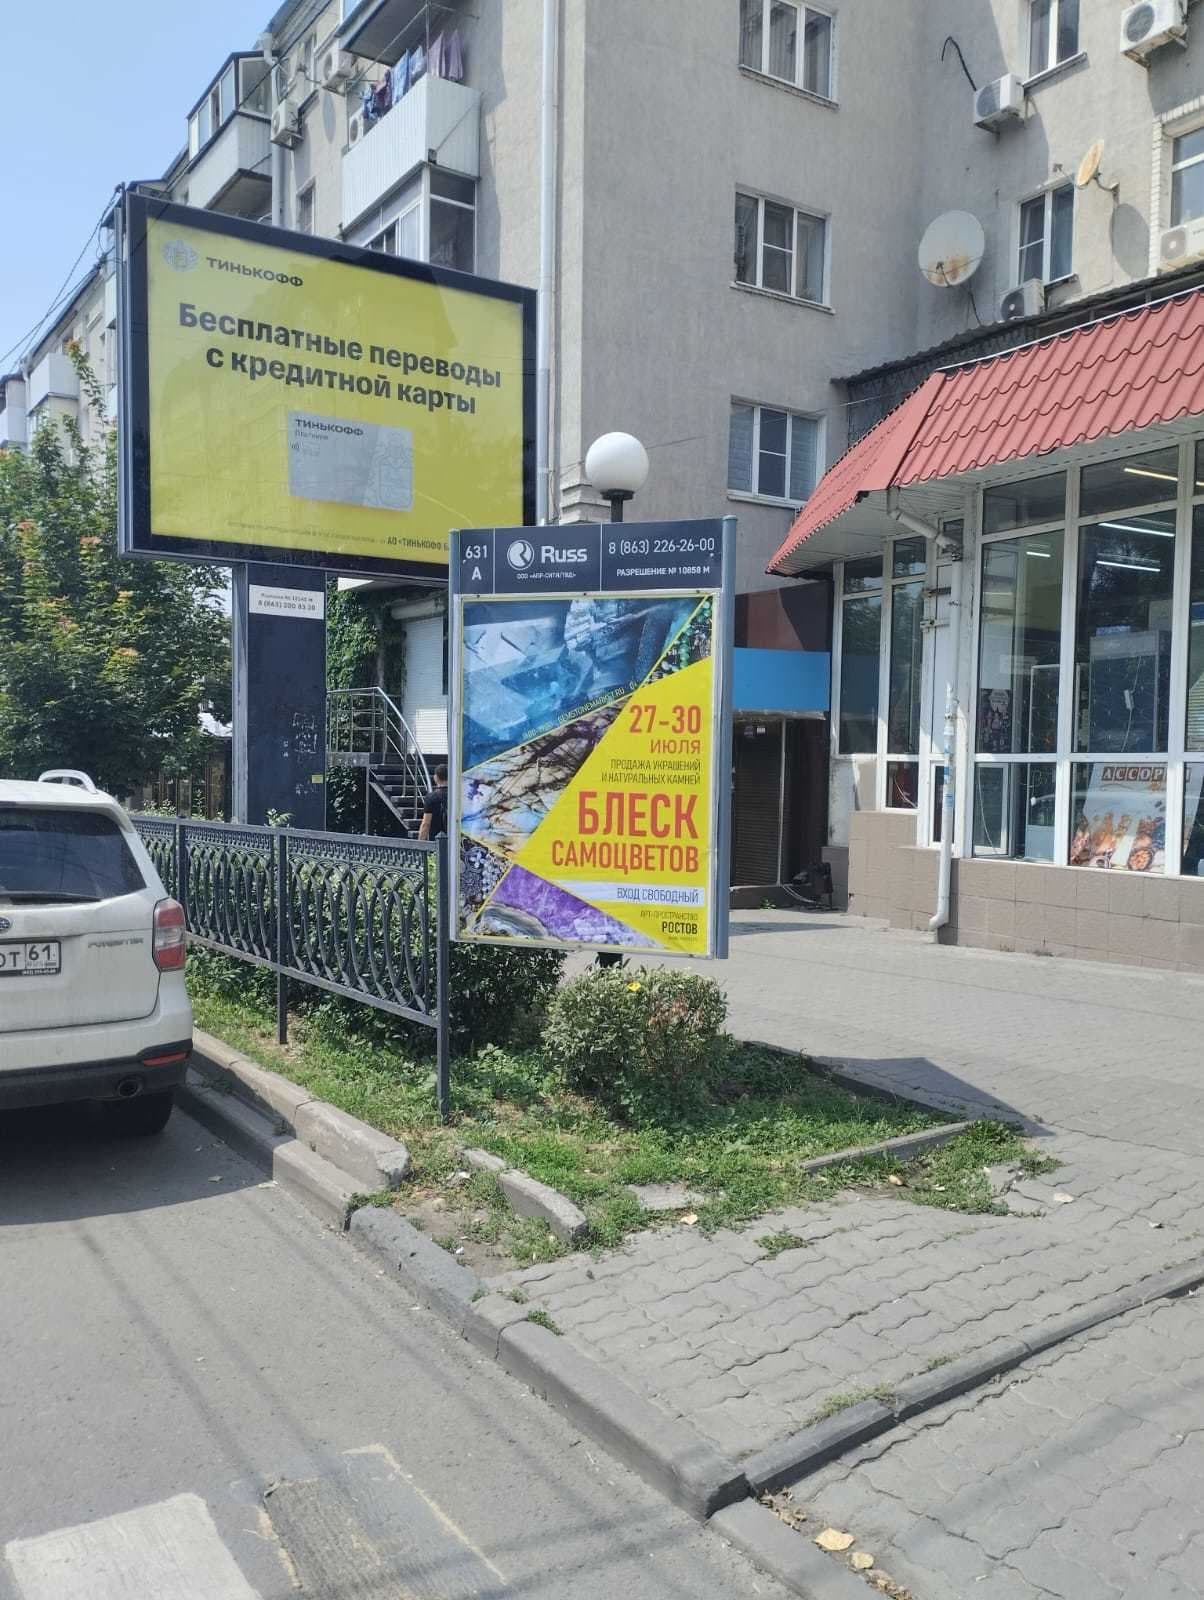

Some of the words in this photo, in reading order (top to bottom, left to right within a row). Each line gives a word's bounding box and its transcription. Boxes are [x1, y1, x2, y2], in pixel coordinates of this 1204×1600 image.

[206, 256, 303, 287] ТИНЬКОФФ
[179, 302, 363, 361] Бесплатные
[370, 345, 501, 388] переводы
[206, 347, 225, 368] с
[231, 351, 391, 398] кредитной
[397, 383, 476, 414] карты
[295, 418, 364, 436] ТИНЬКОФФ
[387, 536, 398, 546] АО
[608, 541, 616, 555] 8
[620, 539, 650, 556] (863)
[653, 537, 715, 553] 226-26-00
[465, 544, 488, 560] 631
[540, 545, 588, 564] Russ
[616, 567, 667, 577] РАЗРЕШЕНИЕ
[650, 739, 701, 755] ИЮЛЯ
[610, 758, 651, 770] ПРОДАЖА
[653, 758, 701, 772] УКРАШЕНИЙ
[601, 772, 608, 783] И
[609, 772, 667, 785] НАТУРАЛЬНЫХ
[668, 773, 701, 785] КАМНЕЙ
[578, 791, 699, 839] БЛЕСК
[551, 840, 699, 875] САМОЦВЕТОВ
[617, 887, 641, 901] ВХОД
[642, 888, 699, 903] СВОБОДНЫЙ
[662, 921, 698, 935] РОСТОВ
[28, 944, 51, 961] 61
